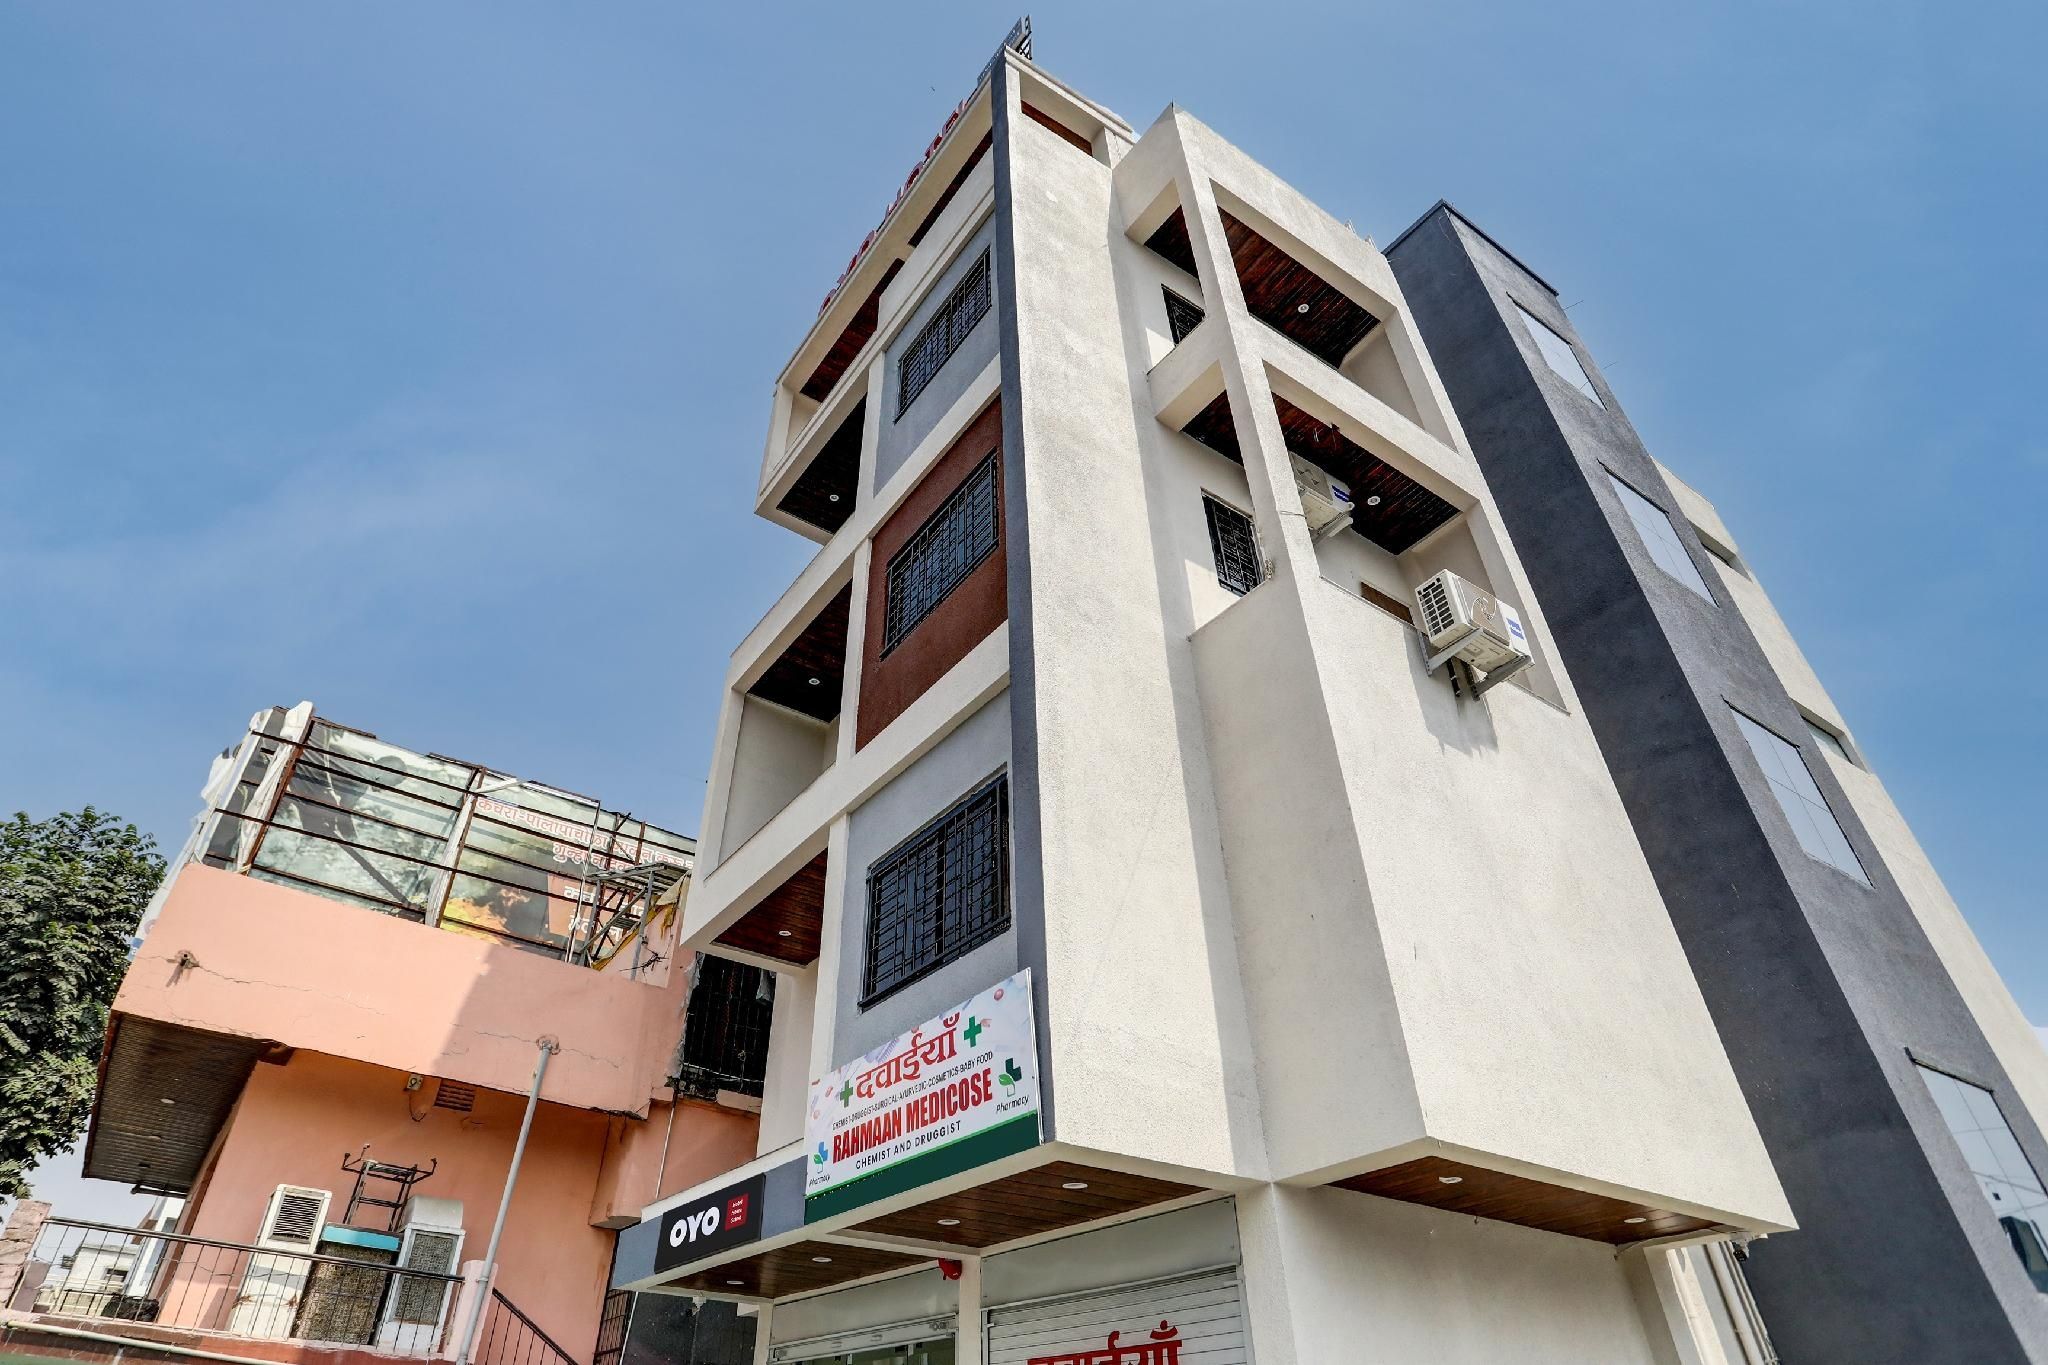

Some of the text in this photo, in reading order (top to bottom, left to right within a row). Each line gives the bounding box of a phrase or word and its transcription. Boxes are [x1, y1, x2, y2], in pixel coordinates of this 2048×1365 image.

[976, 1051, 993, 1066] FOOD
[832, 1068, 993, 1164] RAHMAAN MEDICOSE
[996, 1095, 1029, 1115] Pharmacy
[855, 1120, 962, 1170] CHEMIST AND DRUGGIST
[669, 1206, 720, 1248] OYO
